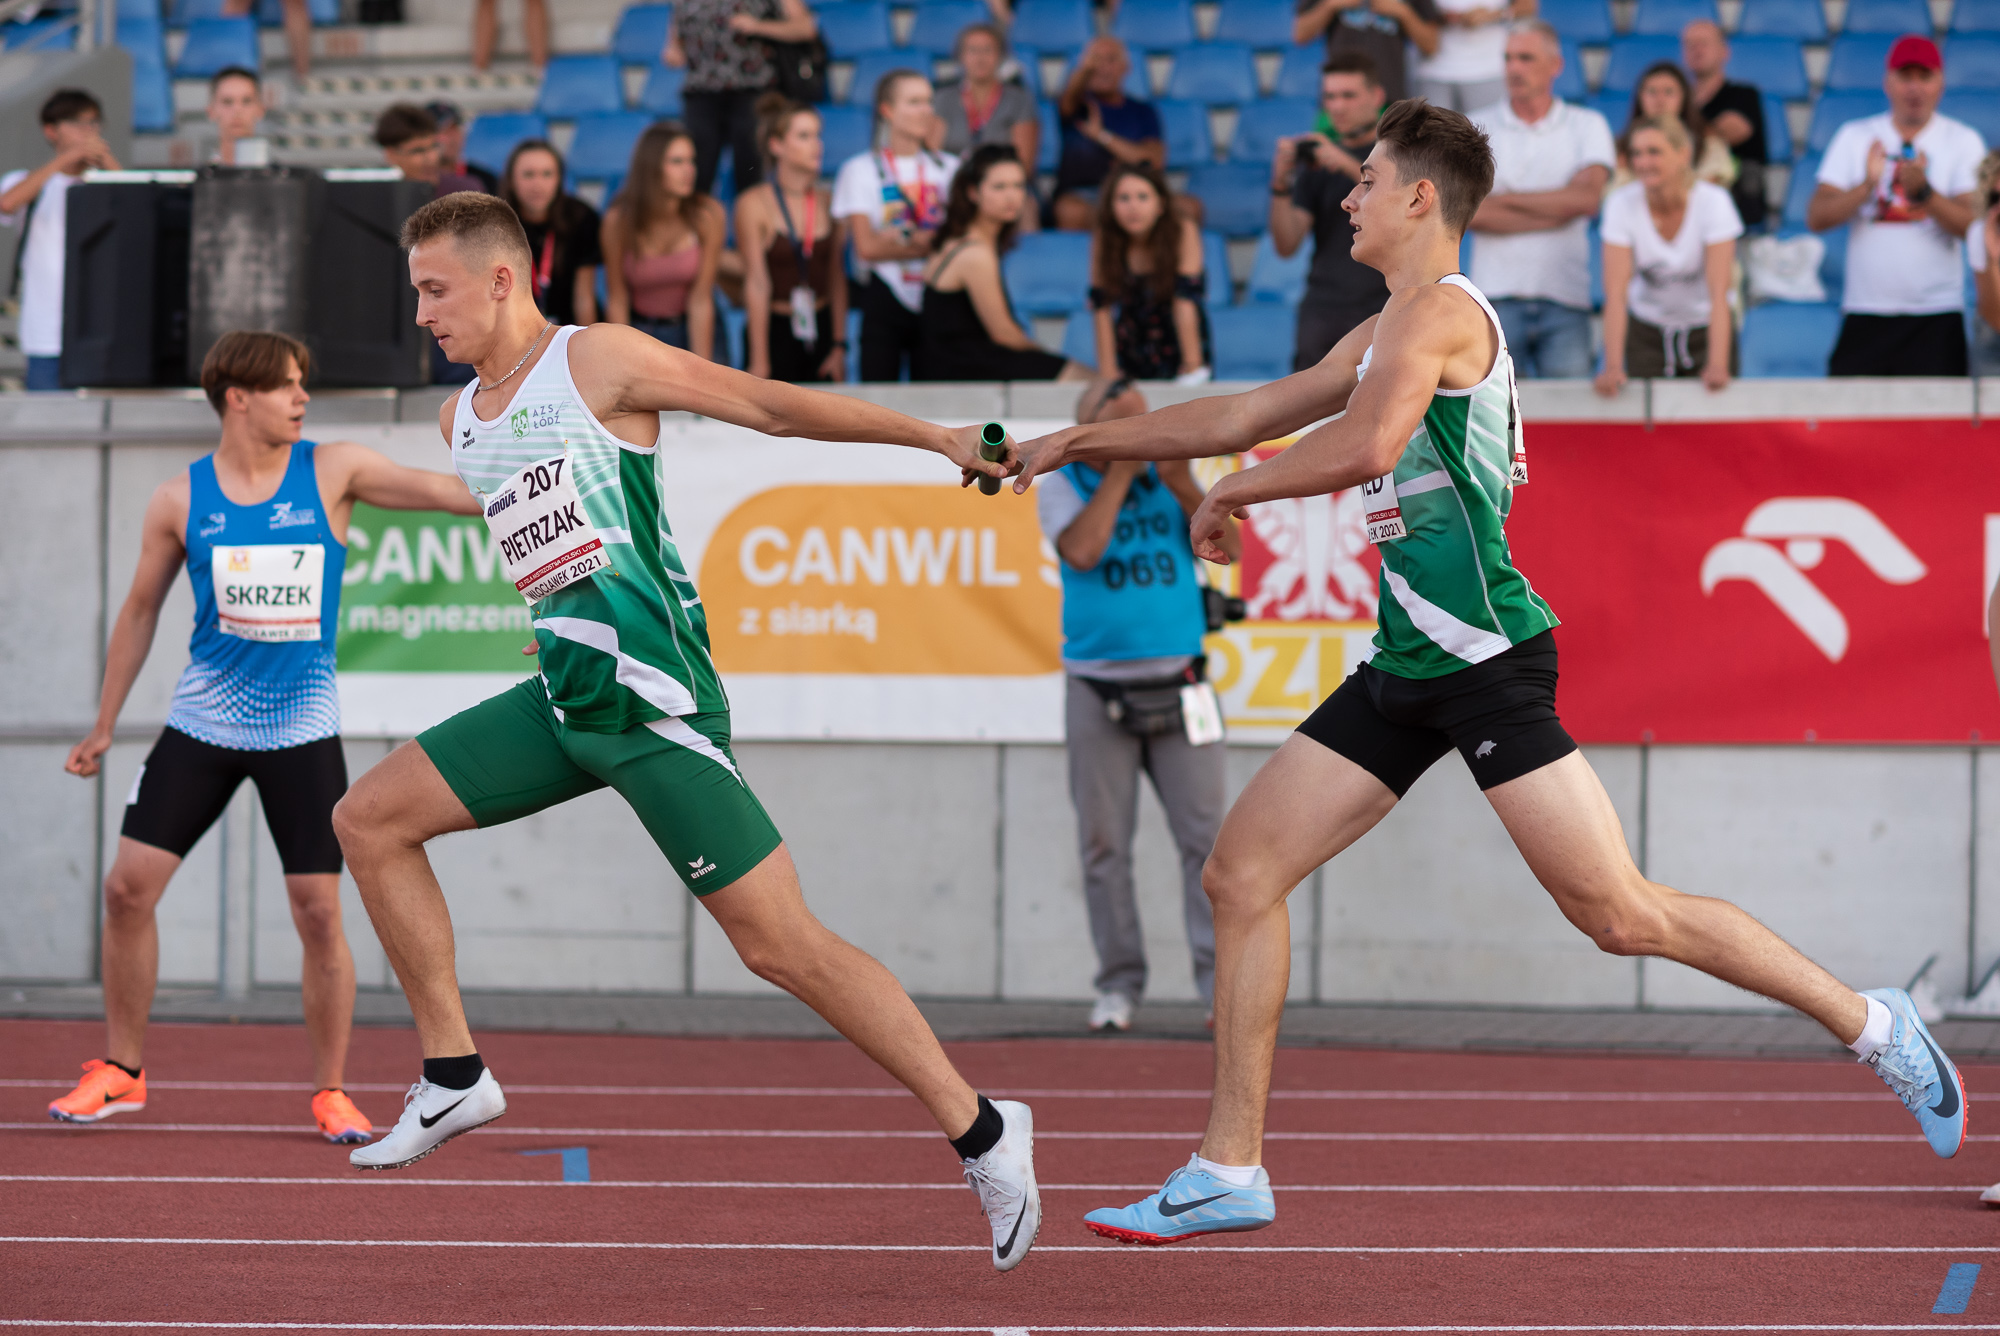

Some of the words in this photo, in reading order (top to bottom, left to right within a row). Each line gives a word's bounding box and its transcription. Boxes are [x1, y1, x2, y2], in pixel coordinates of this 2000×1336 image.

[533, 404, 554, 417] AZS
[523, 458, 565, 500] 207
[500, 501, 585, 565] PIETRZAK
[1116, 511, 1171, 543] OTO
[1379, 523, 1401, 538] 2021
[292, 550, 305, 570] 7
[560, 549, 582, 563] POLSKI
[570, 555, 602, 578] 2021
[739, 525, 1020, 587] CANWIL
[1104, 550, 1176, 591] 069
[226, 585, 312, 606] SKRZEK
[350, 604, 533, 640] magnezem
[738, 607, 761, 635] z
[768, 600, 877, 643] siarką
[690, 863, 717, 879] erima
